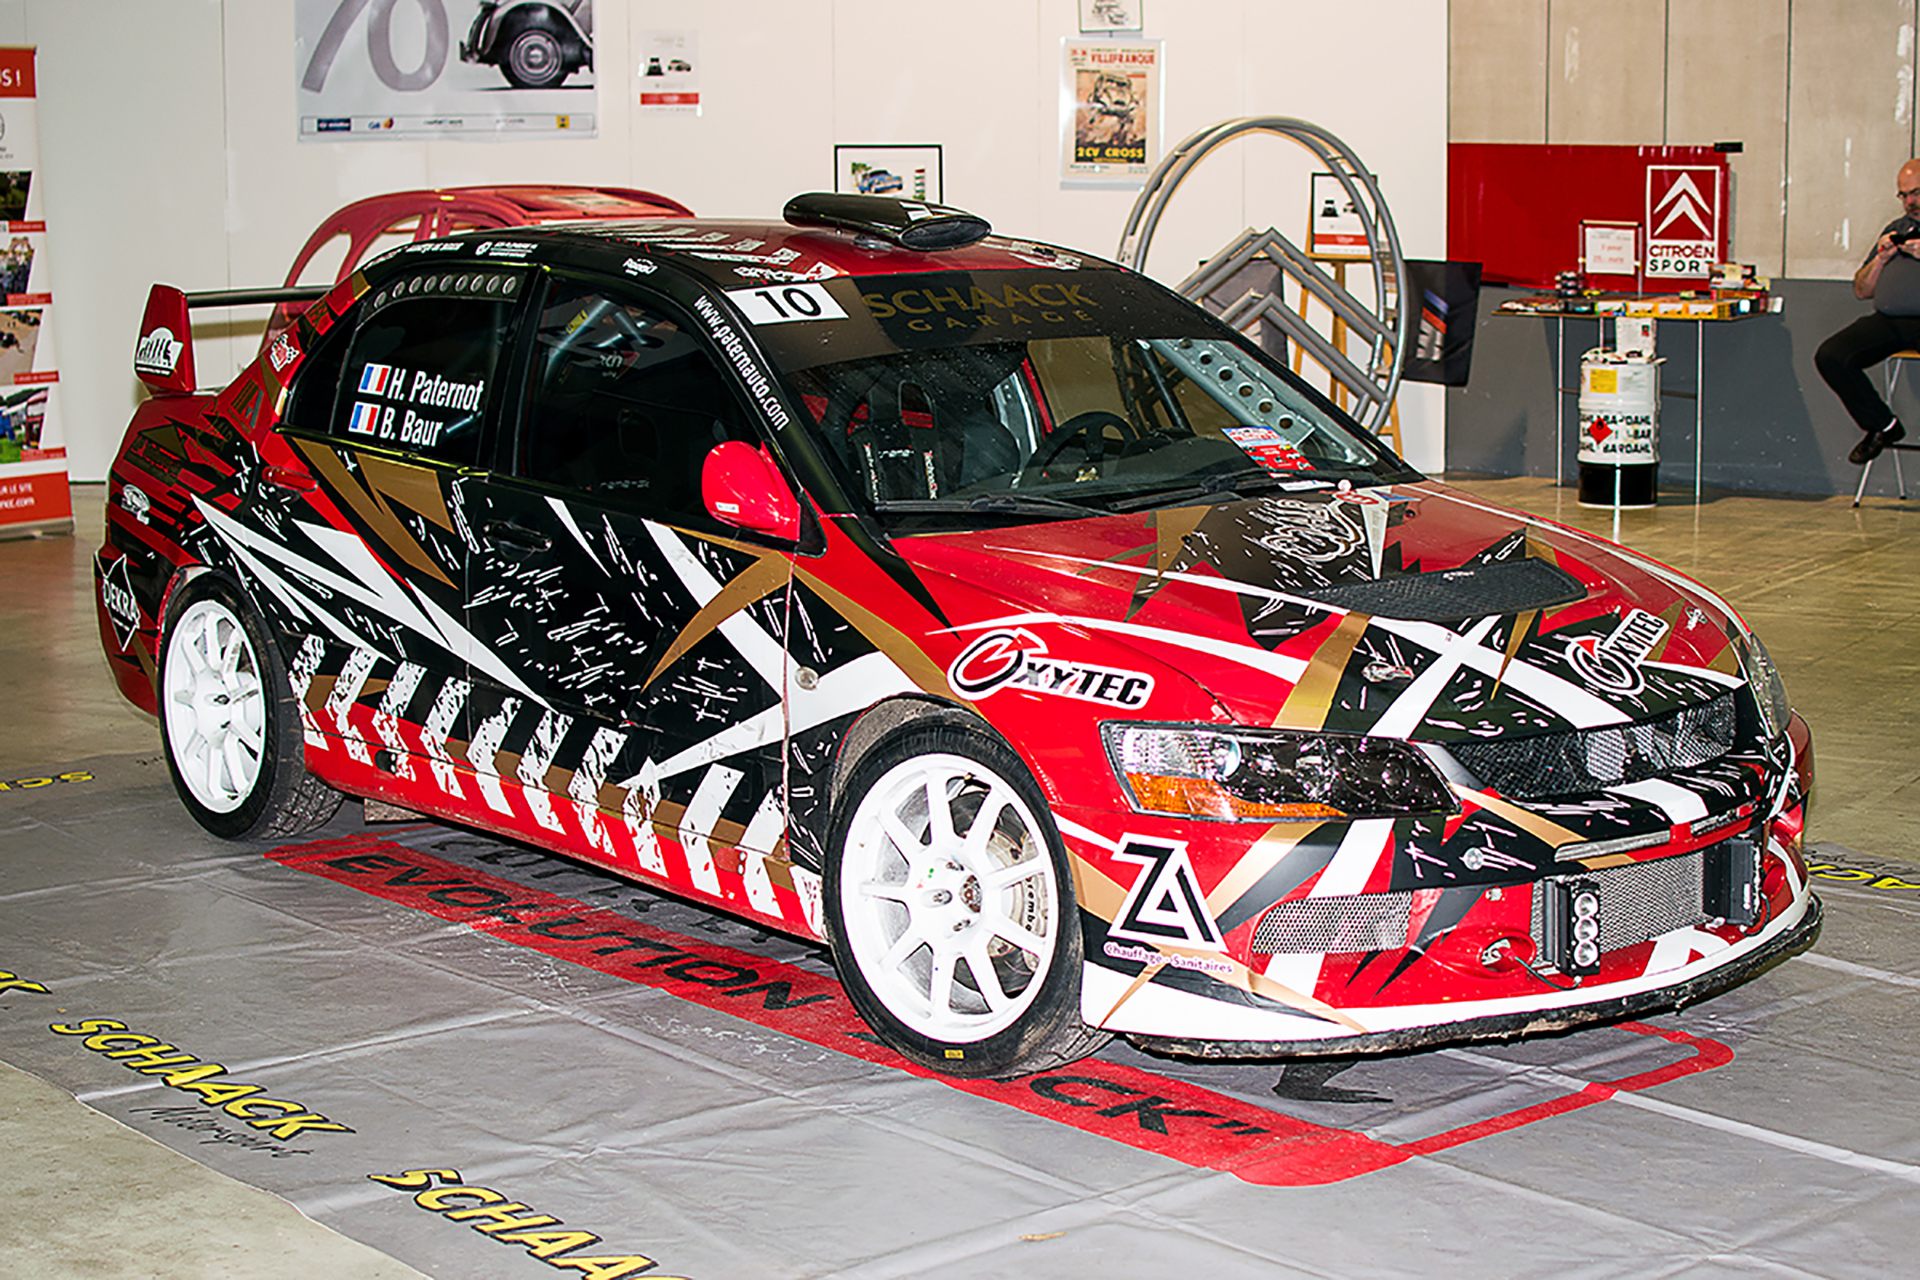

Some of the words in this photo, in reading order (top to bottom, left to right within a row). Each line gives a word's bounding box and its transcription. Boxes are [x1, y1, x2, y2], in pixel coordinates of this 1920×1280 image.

[1105, 147, 1144, 158] CROSS
[1649, 244, 1715, 258] CITROËN
[754, 287, 822, 319] 10
[861, 283, 1099, 319] SCHAACK
[907, 310, 1094, 332] GARAGE
[693, 294, 791, 432] www.paternauto.com
[387, 367, 407, 400] H.
[408, 370, 485, 412] Paternot
[379, 406, 396, 440] B.
[400, 409, 444, 447] Baur
[102, 577, 141, 630] DEKRA
[323, 854, 835, 1011] EVOLUTION
[1174, 953, 1234, 974] Sanitaires
[49, 1017, 357, 1141] SCHAACK
[366, 1166, 695, 1280] SCHAA
